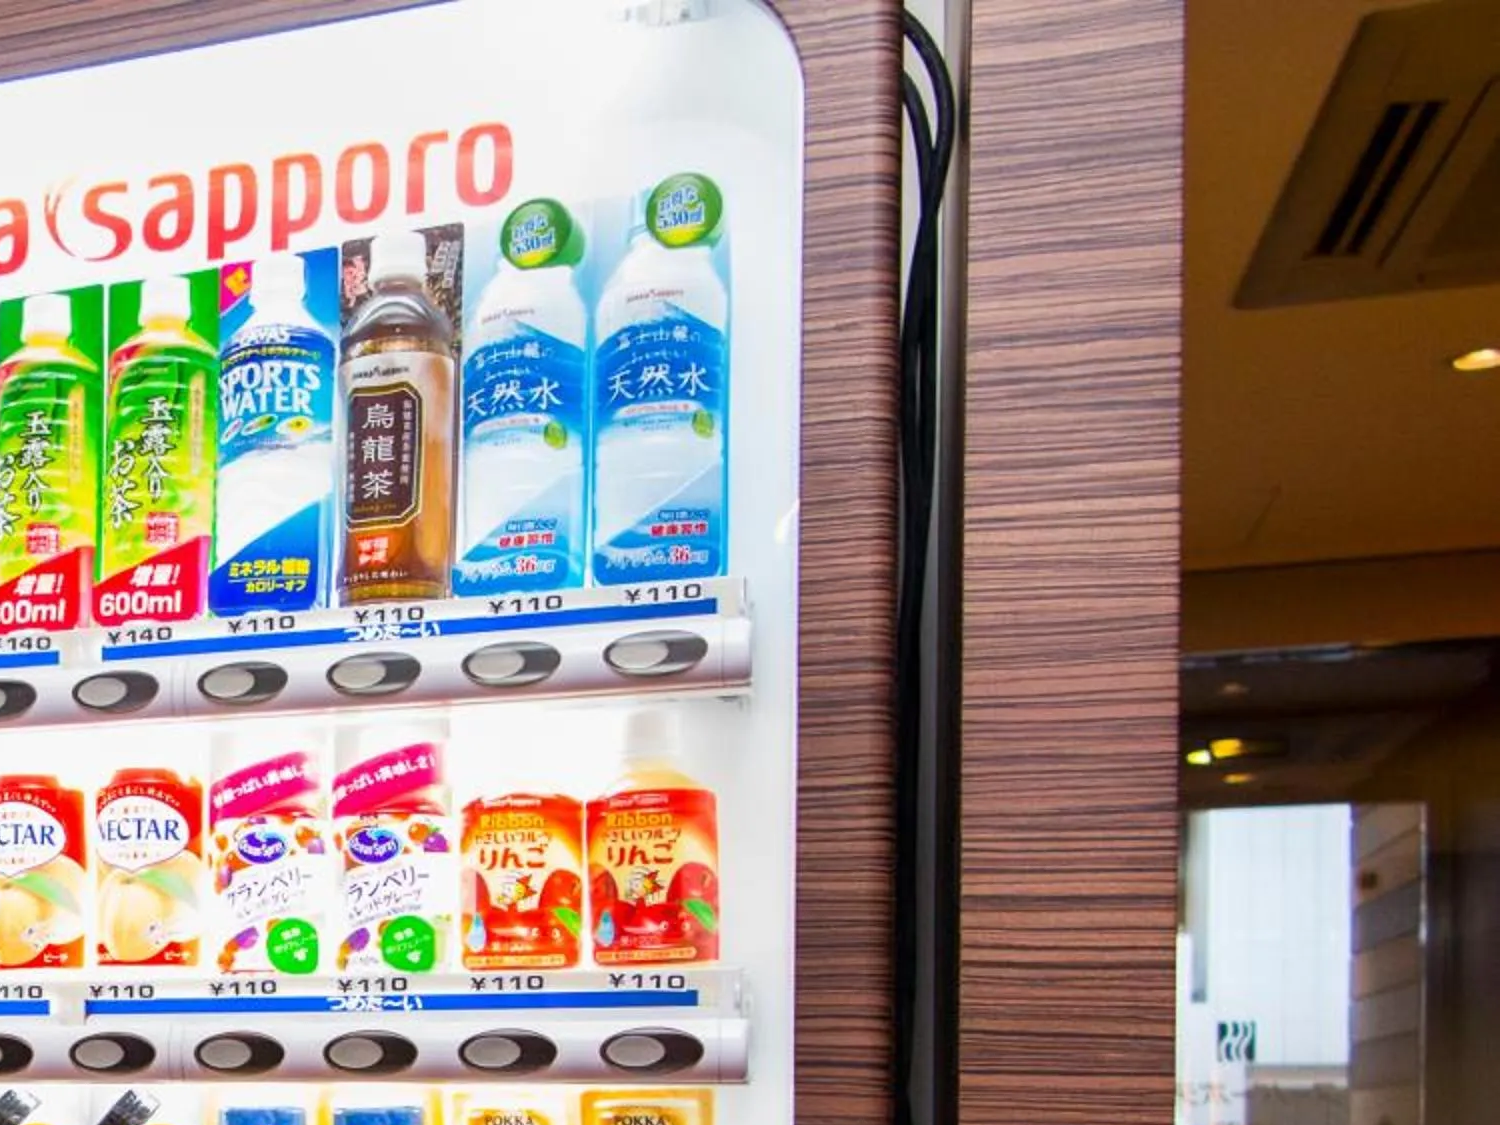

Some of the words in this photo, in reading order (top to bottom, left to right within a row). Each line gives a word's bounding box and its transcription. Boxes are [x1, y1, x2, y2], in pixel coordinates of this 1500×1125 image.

[219, 360, 321, 396] SPORTS
[607, 362, 712, 403] 天然水
[221, 386, 315, 422] WATER
[467, 376, 564, 421] 天然水
[141, 396, 178, 503] 玉露入り
[361, 402, 397, 499] 烏龍茶
[20, 411, 53, 514] 玉露入り
[110, 439, 142, 529] お茶
[245, 579, 307, 594] カロリーオフ
[625, 583, 702, 603] ¥110
[99, 591, 183, 617] 600ml
[489, 595, 563, 614] ¥110
[228, 615, 296, 634] ¥110
[355, 607, 426, 625] ¥110
[107, 626, 174, 646] ¥140
[480, 812, 545, 829] Ribbon
[606, 811, 673, 828] Ribbon
[479, 843, 549, 870] りんご
[607, 838, 678, 867] りんご
[349, 866, 430, 904] ランベリー
[209, 979, 277, 996] ¥110
[337, 976, 408, 993] ¥110
[470, 975, 545, 991] ¥110
[609, 973, 686, 989] ¥110
[90, 984, 154, 999] ¥110
